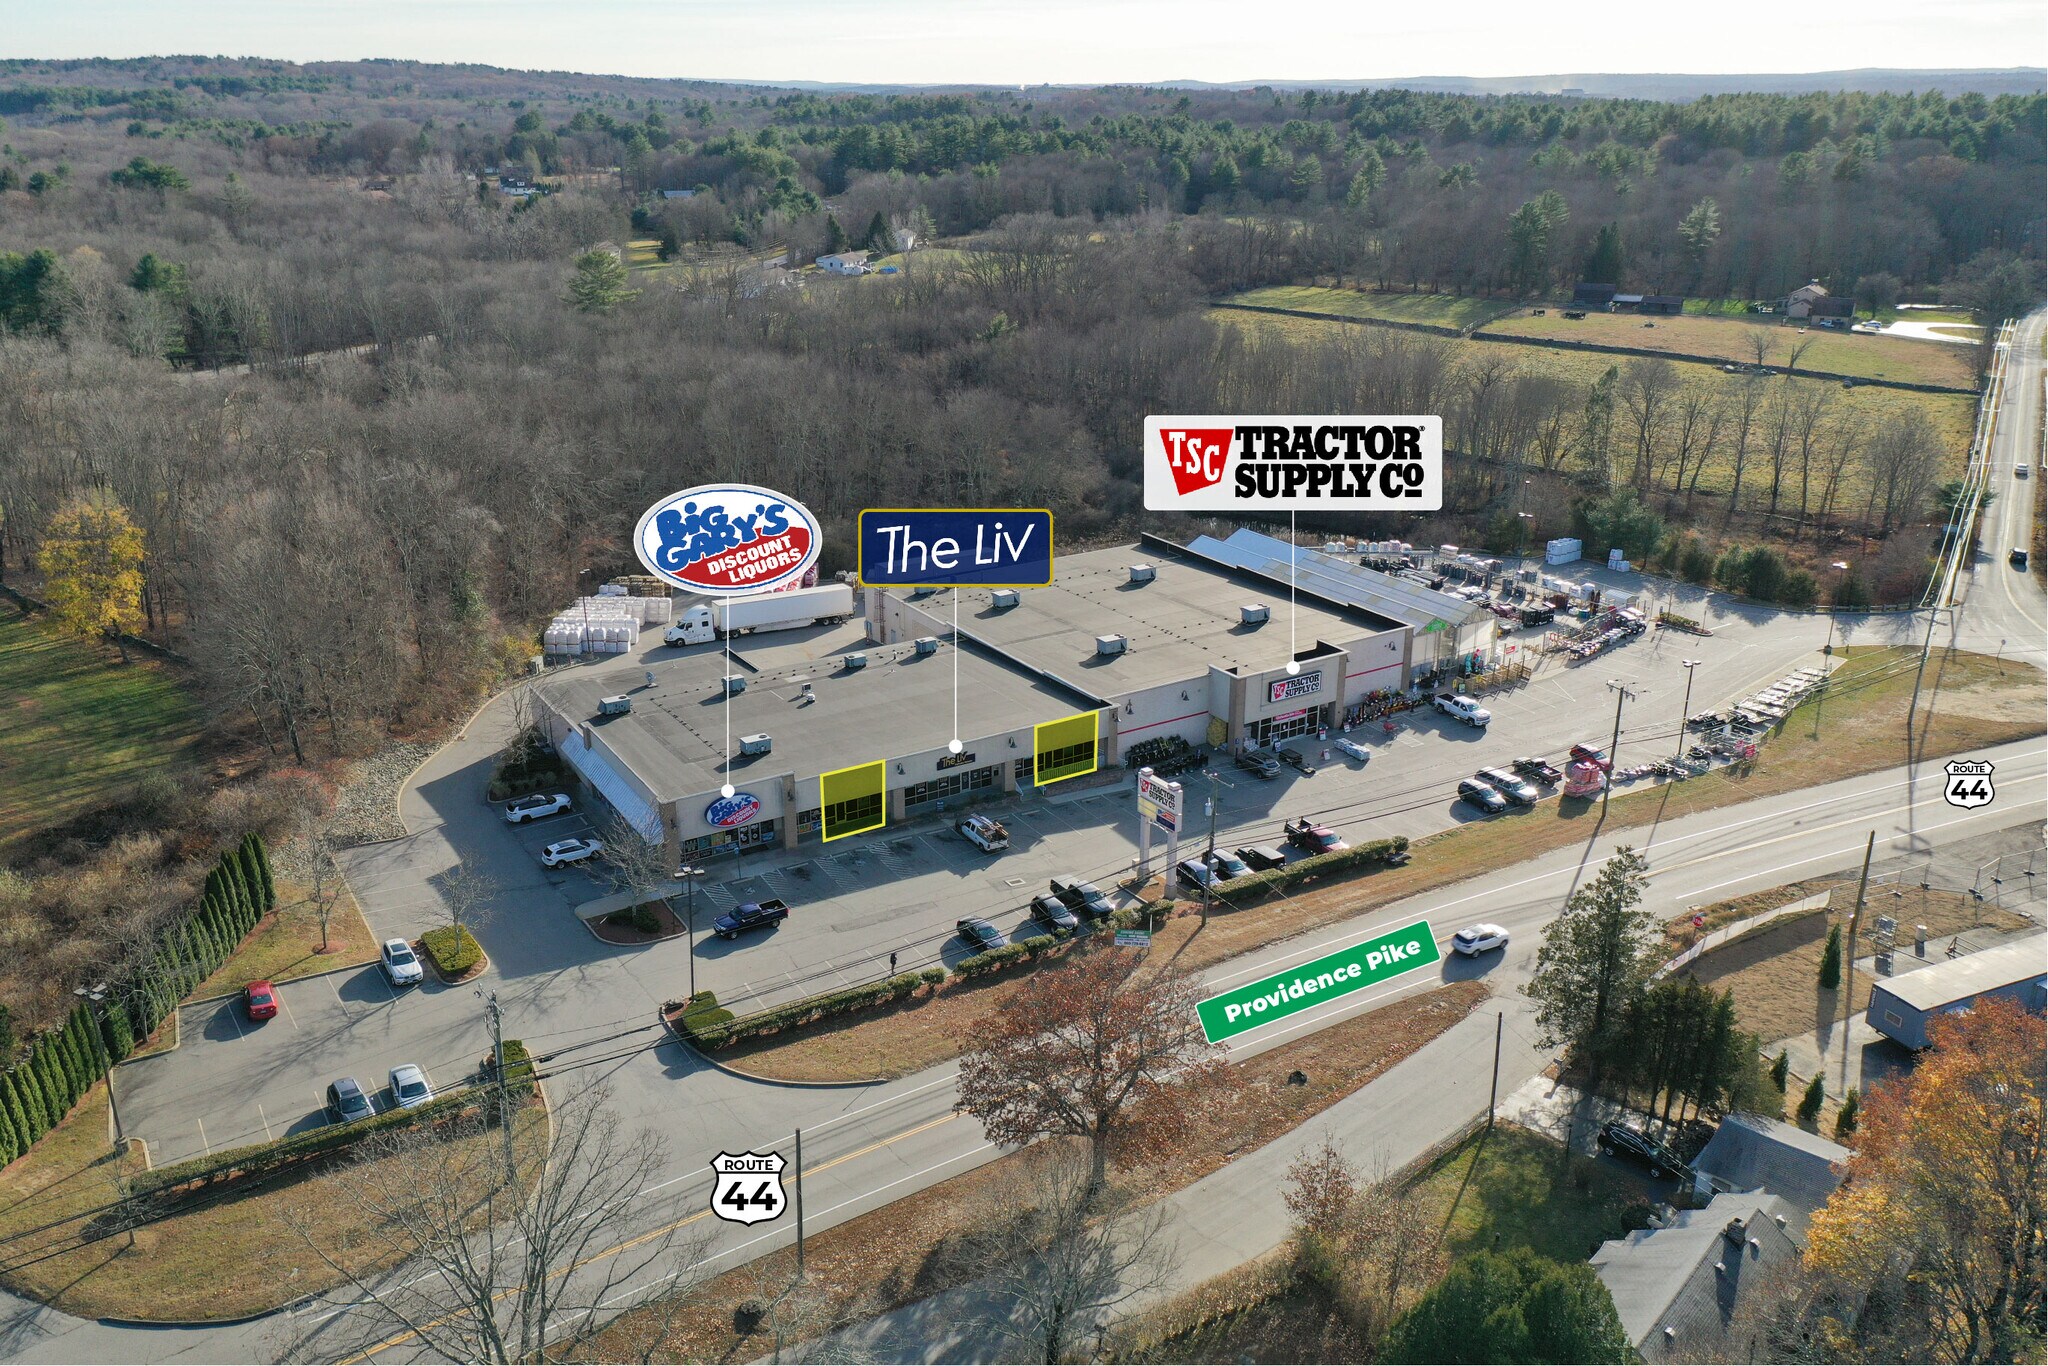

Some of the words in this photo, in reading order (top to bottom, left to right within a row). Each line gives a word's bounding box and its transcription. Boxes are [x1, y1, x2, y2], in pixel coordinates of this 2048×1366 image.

[1286, 674, 1319, 688] TRACTOR
[1285, 684, 1311, 698] SUPPLY
[941, 756, 956, 768] The
[1149, 783, 1175, 802] TRACTOR
[1149, 790, 1168, 806] SUPPLY
[727, 805, 753, 823] DISCOUNT
[733, 807, 757, 824] LIQUORS
